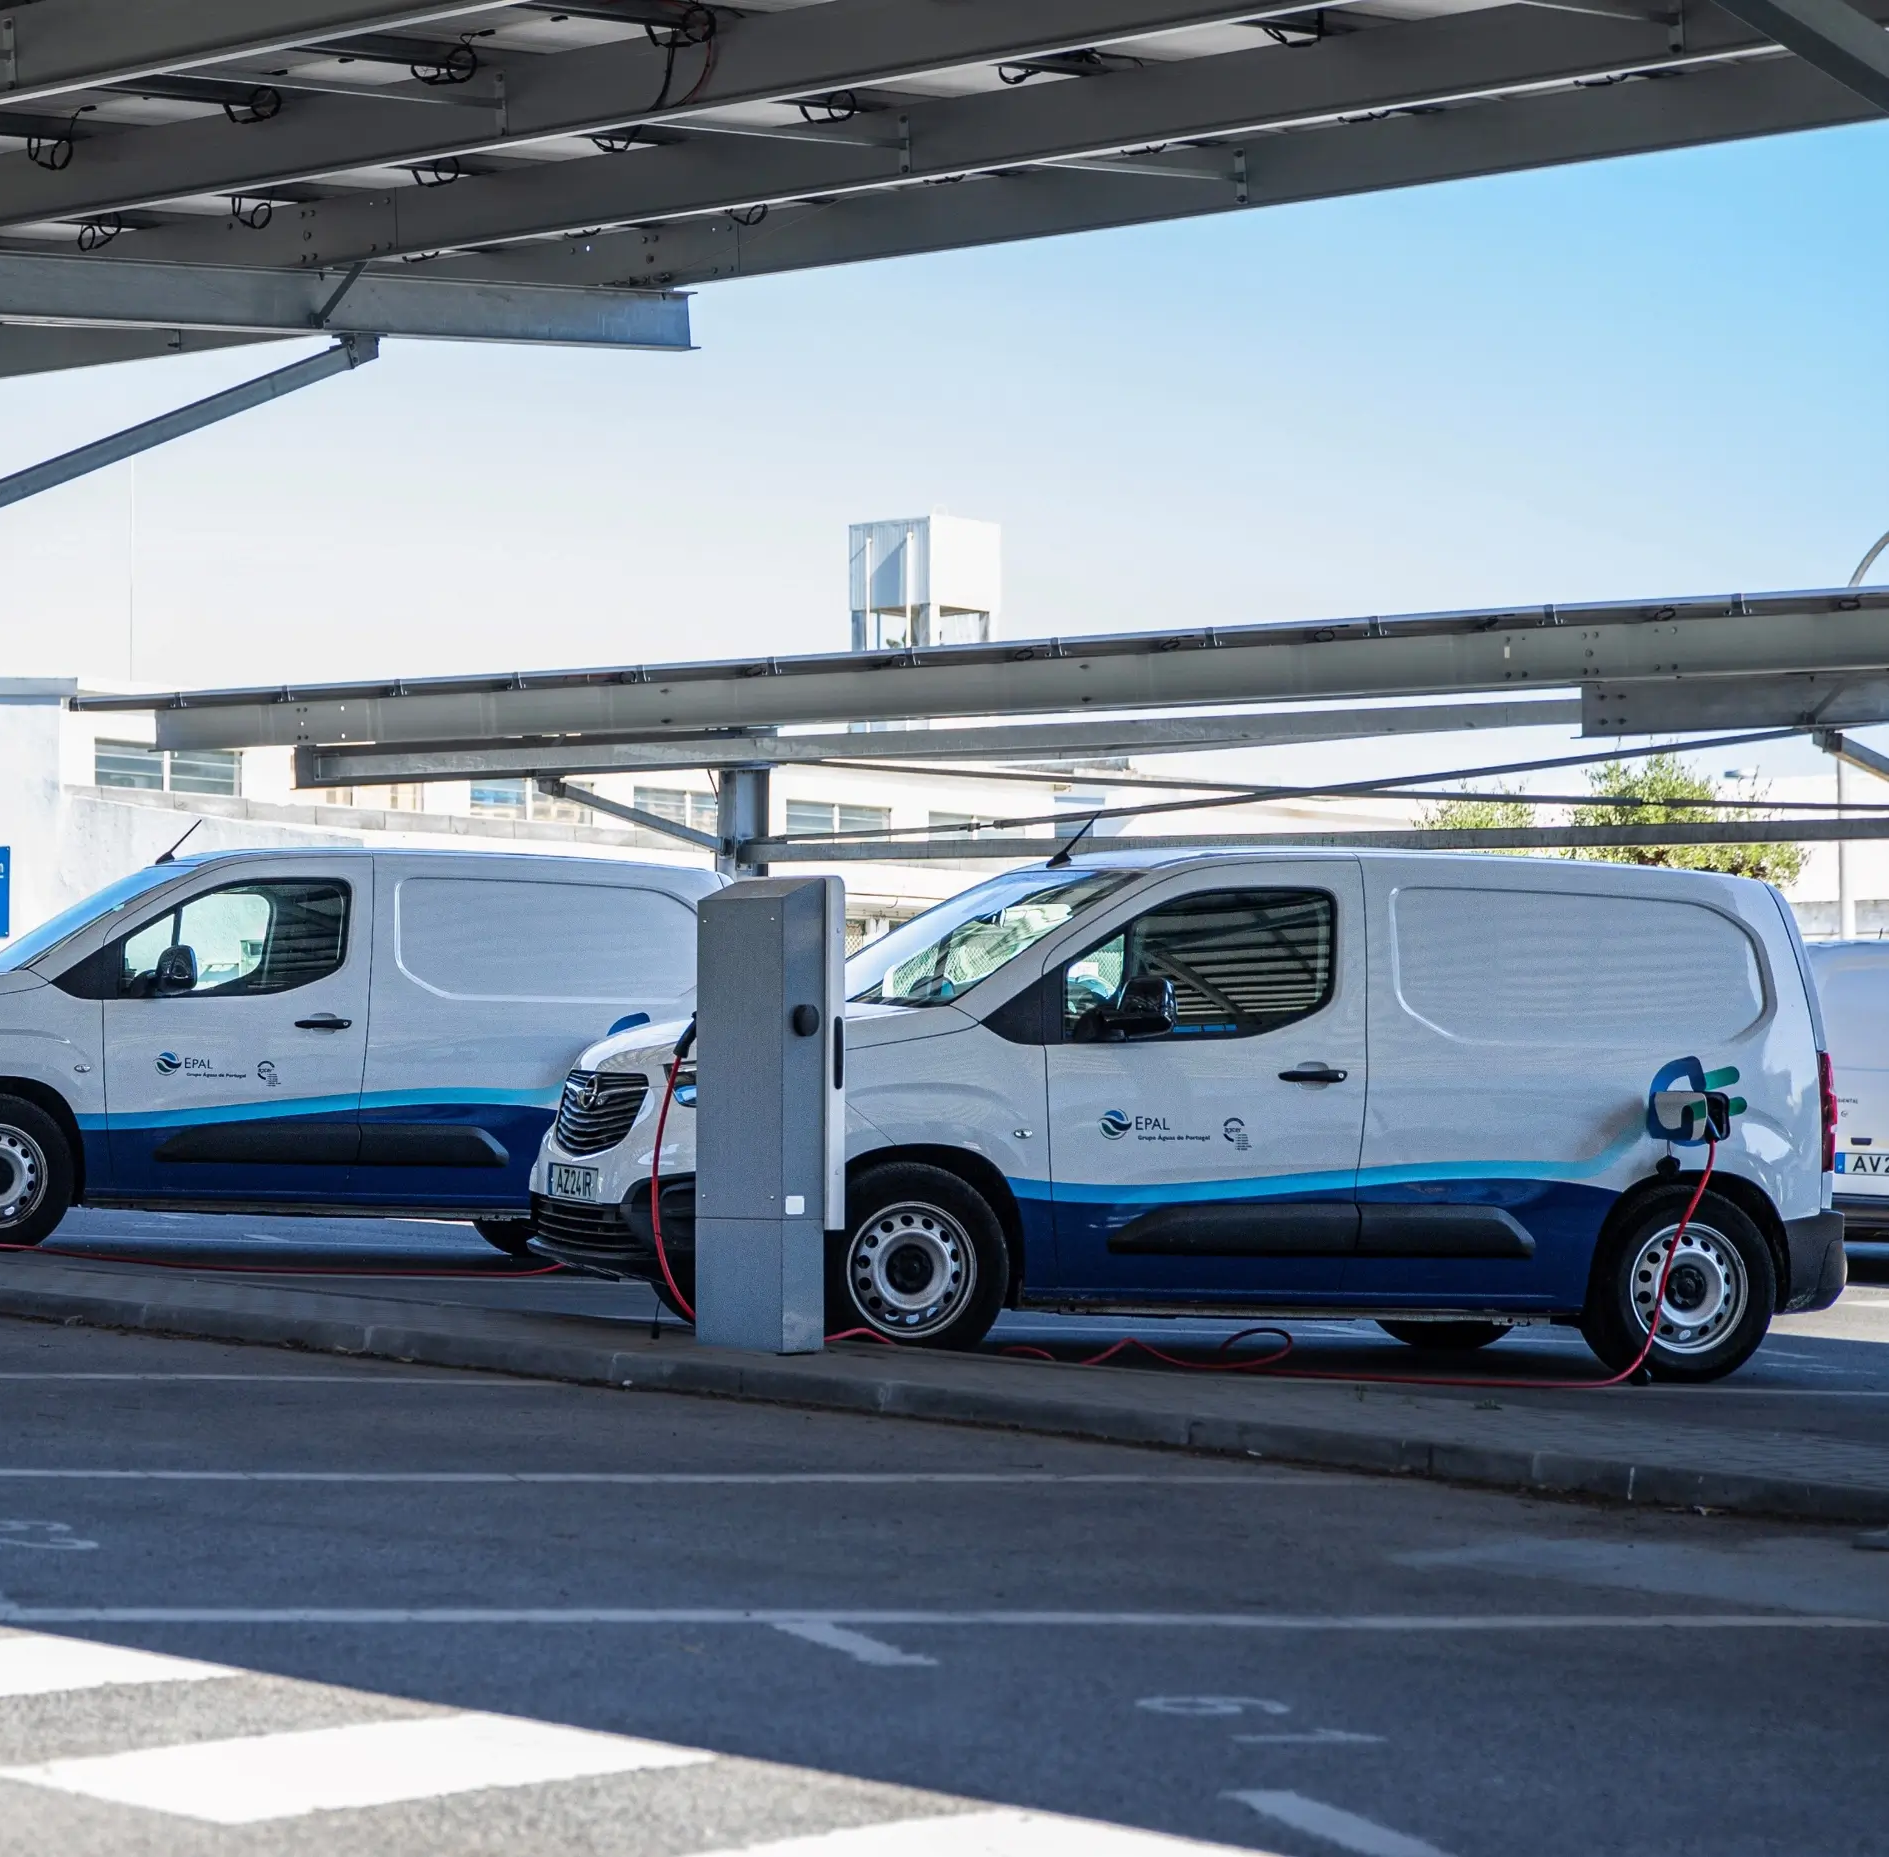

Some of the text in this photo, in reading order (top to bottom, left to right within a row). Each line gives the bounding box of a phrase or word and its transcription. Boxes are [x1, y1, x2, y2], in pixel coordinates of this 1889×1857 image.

[184, 1057, 213, 1069] EPAL
[1135, 1116, 1170, 1131] EPAL
[1185, 1134, 1210, 1142] Portugal
